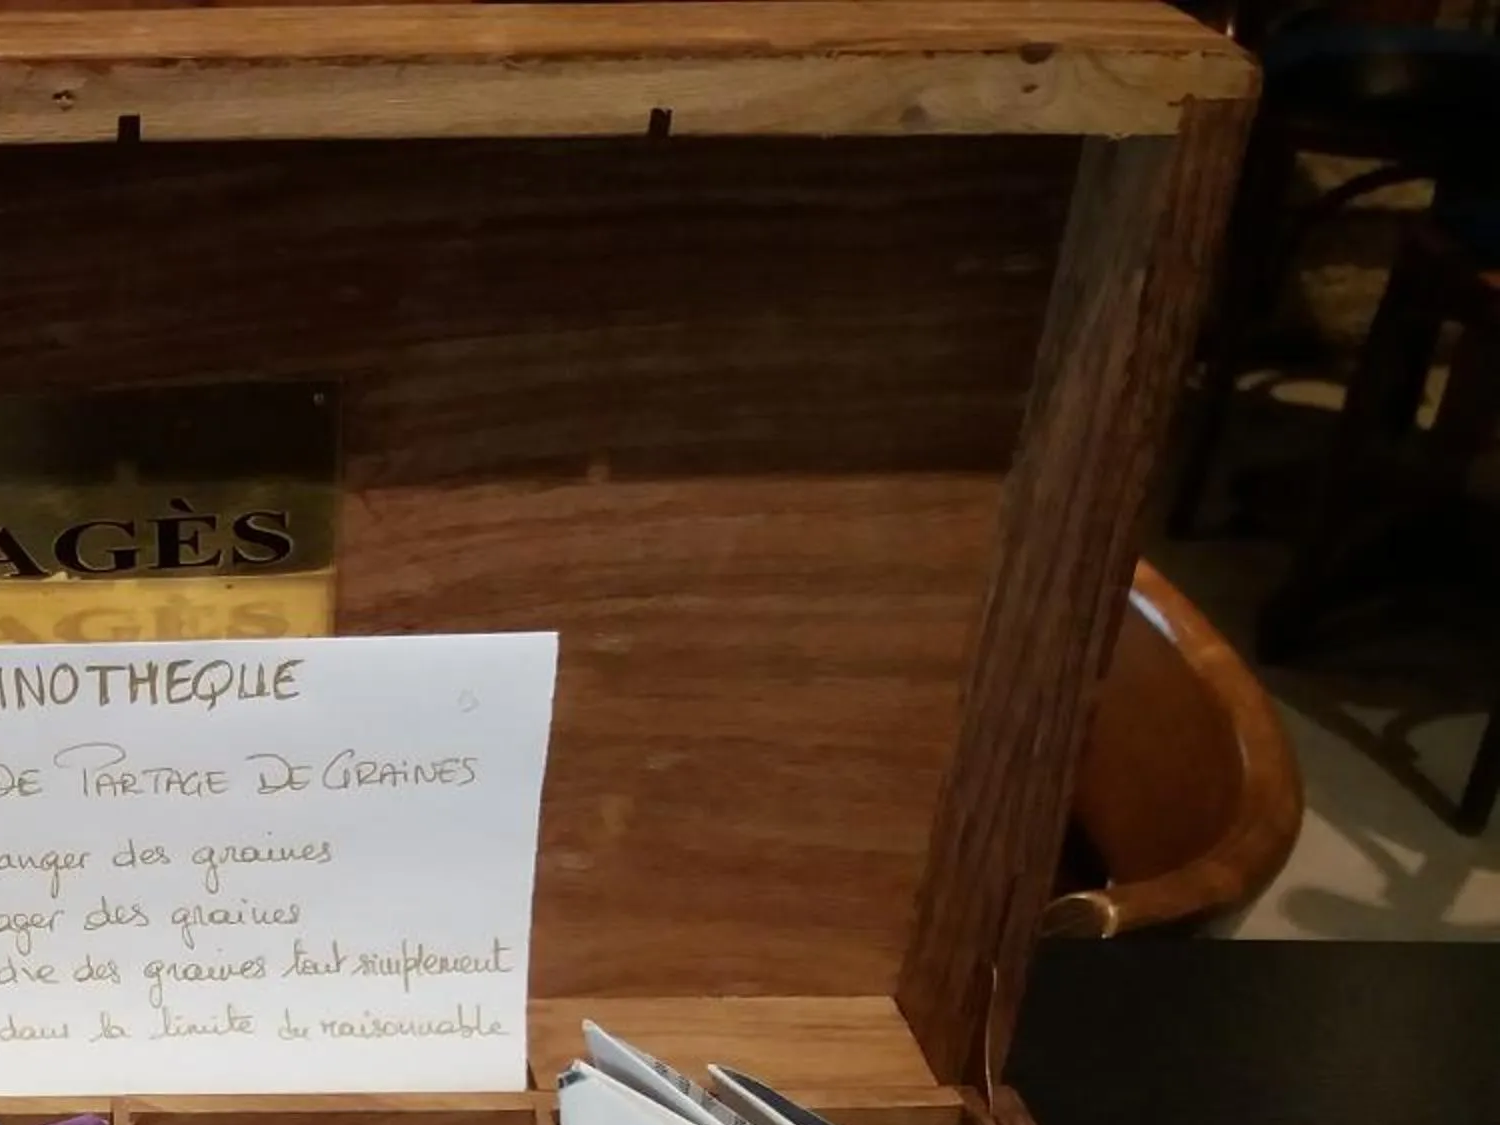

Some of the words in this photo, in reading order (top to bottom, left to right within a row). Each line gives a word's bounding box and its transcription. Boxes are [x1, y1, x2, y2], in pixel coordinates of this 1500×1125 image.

[54, 743, 229, 798] PARTAGE
[244, 753, 312, 792] DE
[111, 839, 172, 869] des
[191, 831, 333, 894] graines
[82, 896, 151, 932] des
[171, 898, 302, 950] graines
[72, 953, 122, 986] des
[143, 948, 267, 1009] graines
[282, 938, 347, 979] tout
[351, 936, 514, 993] simplement
[88, 1009, 131, 1043] la
[148, 1003, 256, 1042] limite
[319, 1003, 511, 1040] raisonnable
